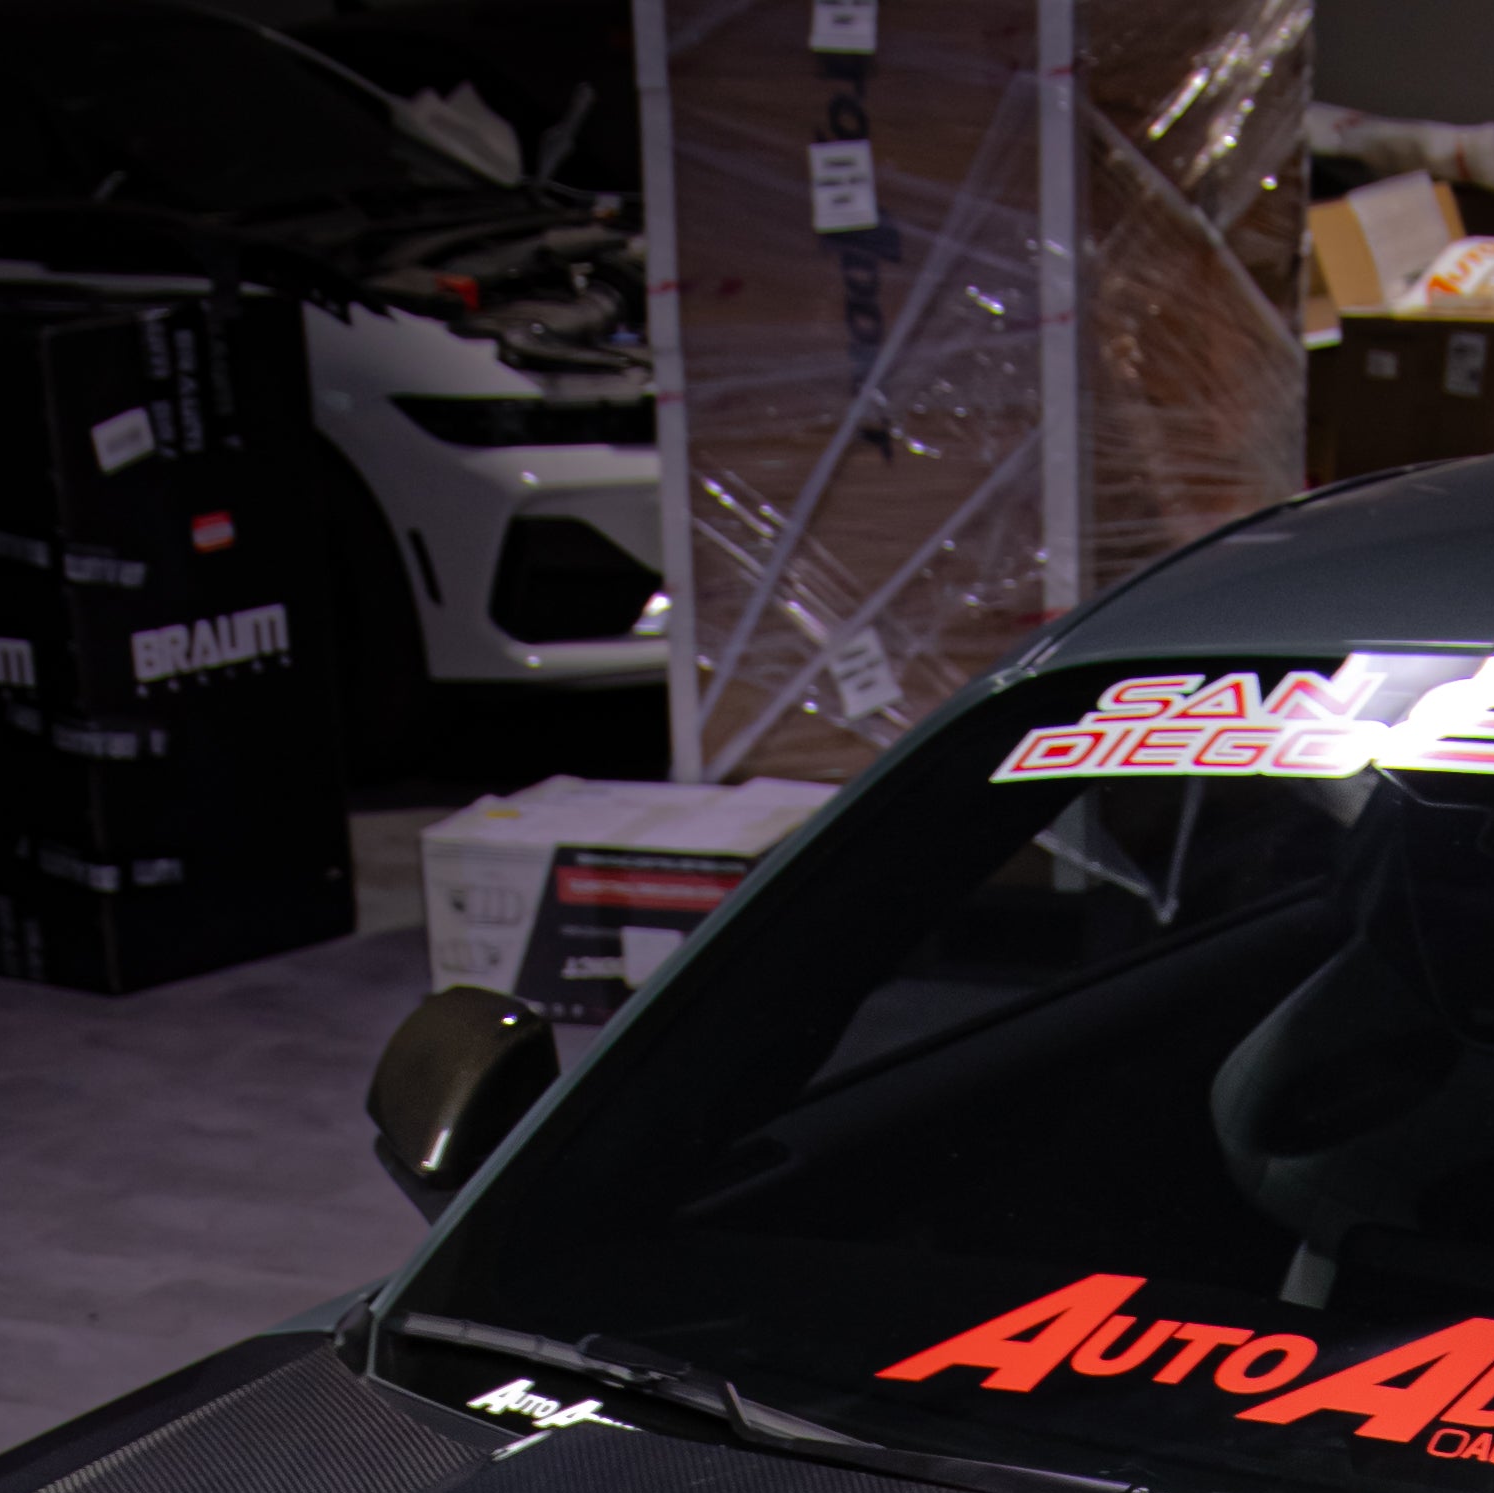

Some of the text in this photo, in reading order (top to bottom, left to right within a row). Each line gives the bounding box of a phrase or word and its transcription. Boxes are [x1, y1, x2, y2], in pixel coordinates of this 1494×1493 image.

[130, 601, 290, 685] BRAUM
[1078, 672, 1387, 723] SAN
[989, 720, 1391, 783] DIEGO
[874, 1273, 1318, 1393] AUTO
